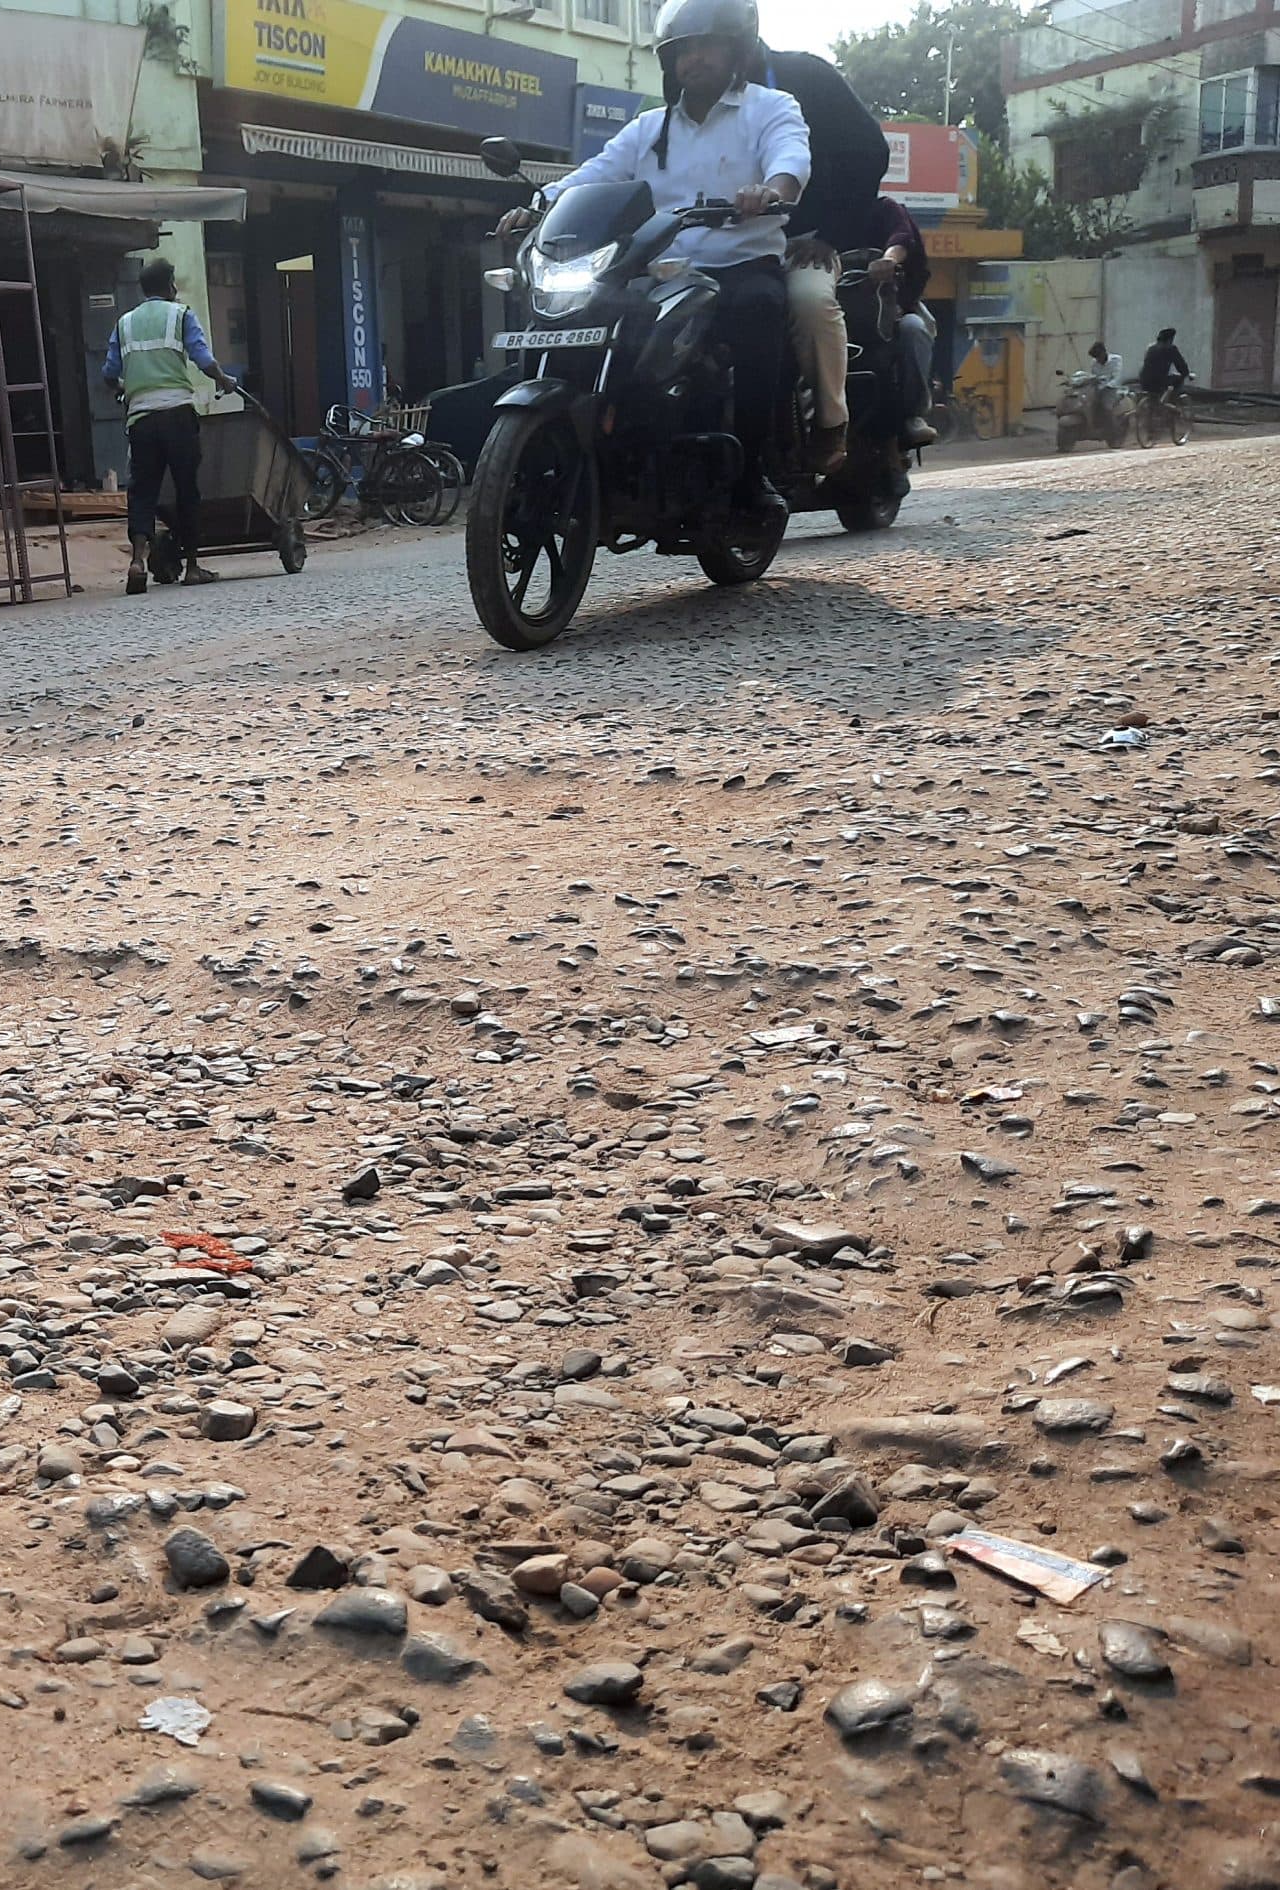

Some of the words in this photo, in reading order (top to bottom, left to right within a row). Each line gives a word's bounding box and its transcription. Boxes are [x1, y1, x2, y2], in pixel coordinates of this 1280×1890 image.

[254, 21, 326, 59] TISCON
[272, 71, 285, 85] OF
[287, 76, 326, 93] BUILDING
[424, 51, 502, 87] KAMAKHYA
[504, 70, 544, 97] STEEL
[342, 216, 366, 232] TATA
[925, 233, 963, 254] TEEL
[348, 237, 367, 368] TISCON
[506, 335, 524, 347] BR
[528, 333, 563, 346] 06CG
[566, 330, 602, 344] 2860
[352, 369, 371, 388] 550
